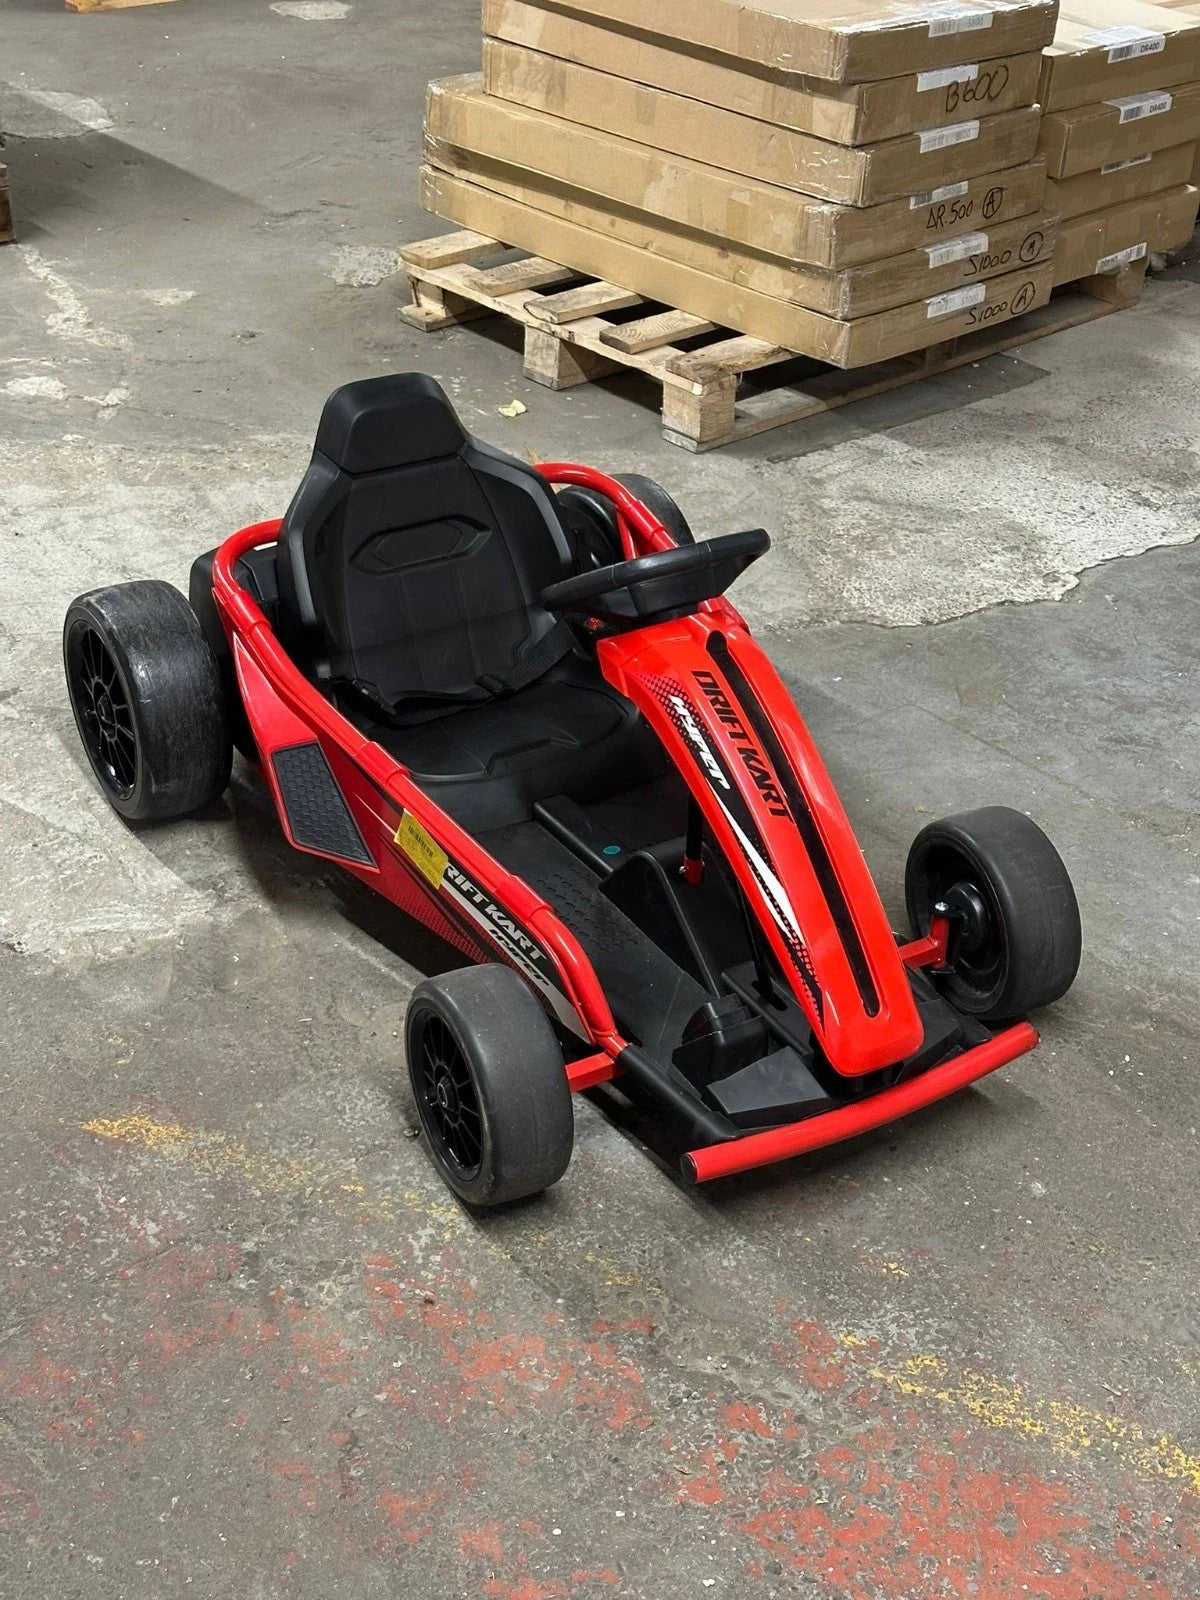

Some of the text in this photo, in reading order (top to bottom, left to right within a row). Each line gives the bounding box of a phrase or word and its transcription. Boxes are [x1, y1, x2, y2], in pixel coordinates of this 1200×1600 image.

[945, 64, 1009, 113] B600
[963, 250, 1012, 276] S1000
[964, 301, 1008, 325] S1000
[690, 670, 796, 824] DRIFT KART
[446, 861, 548, 960] RIFT KART
